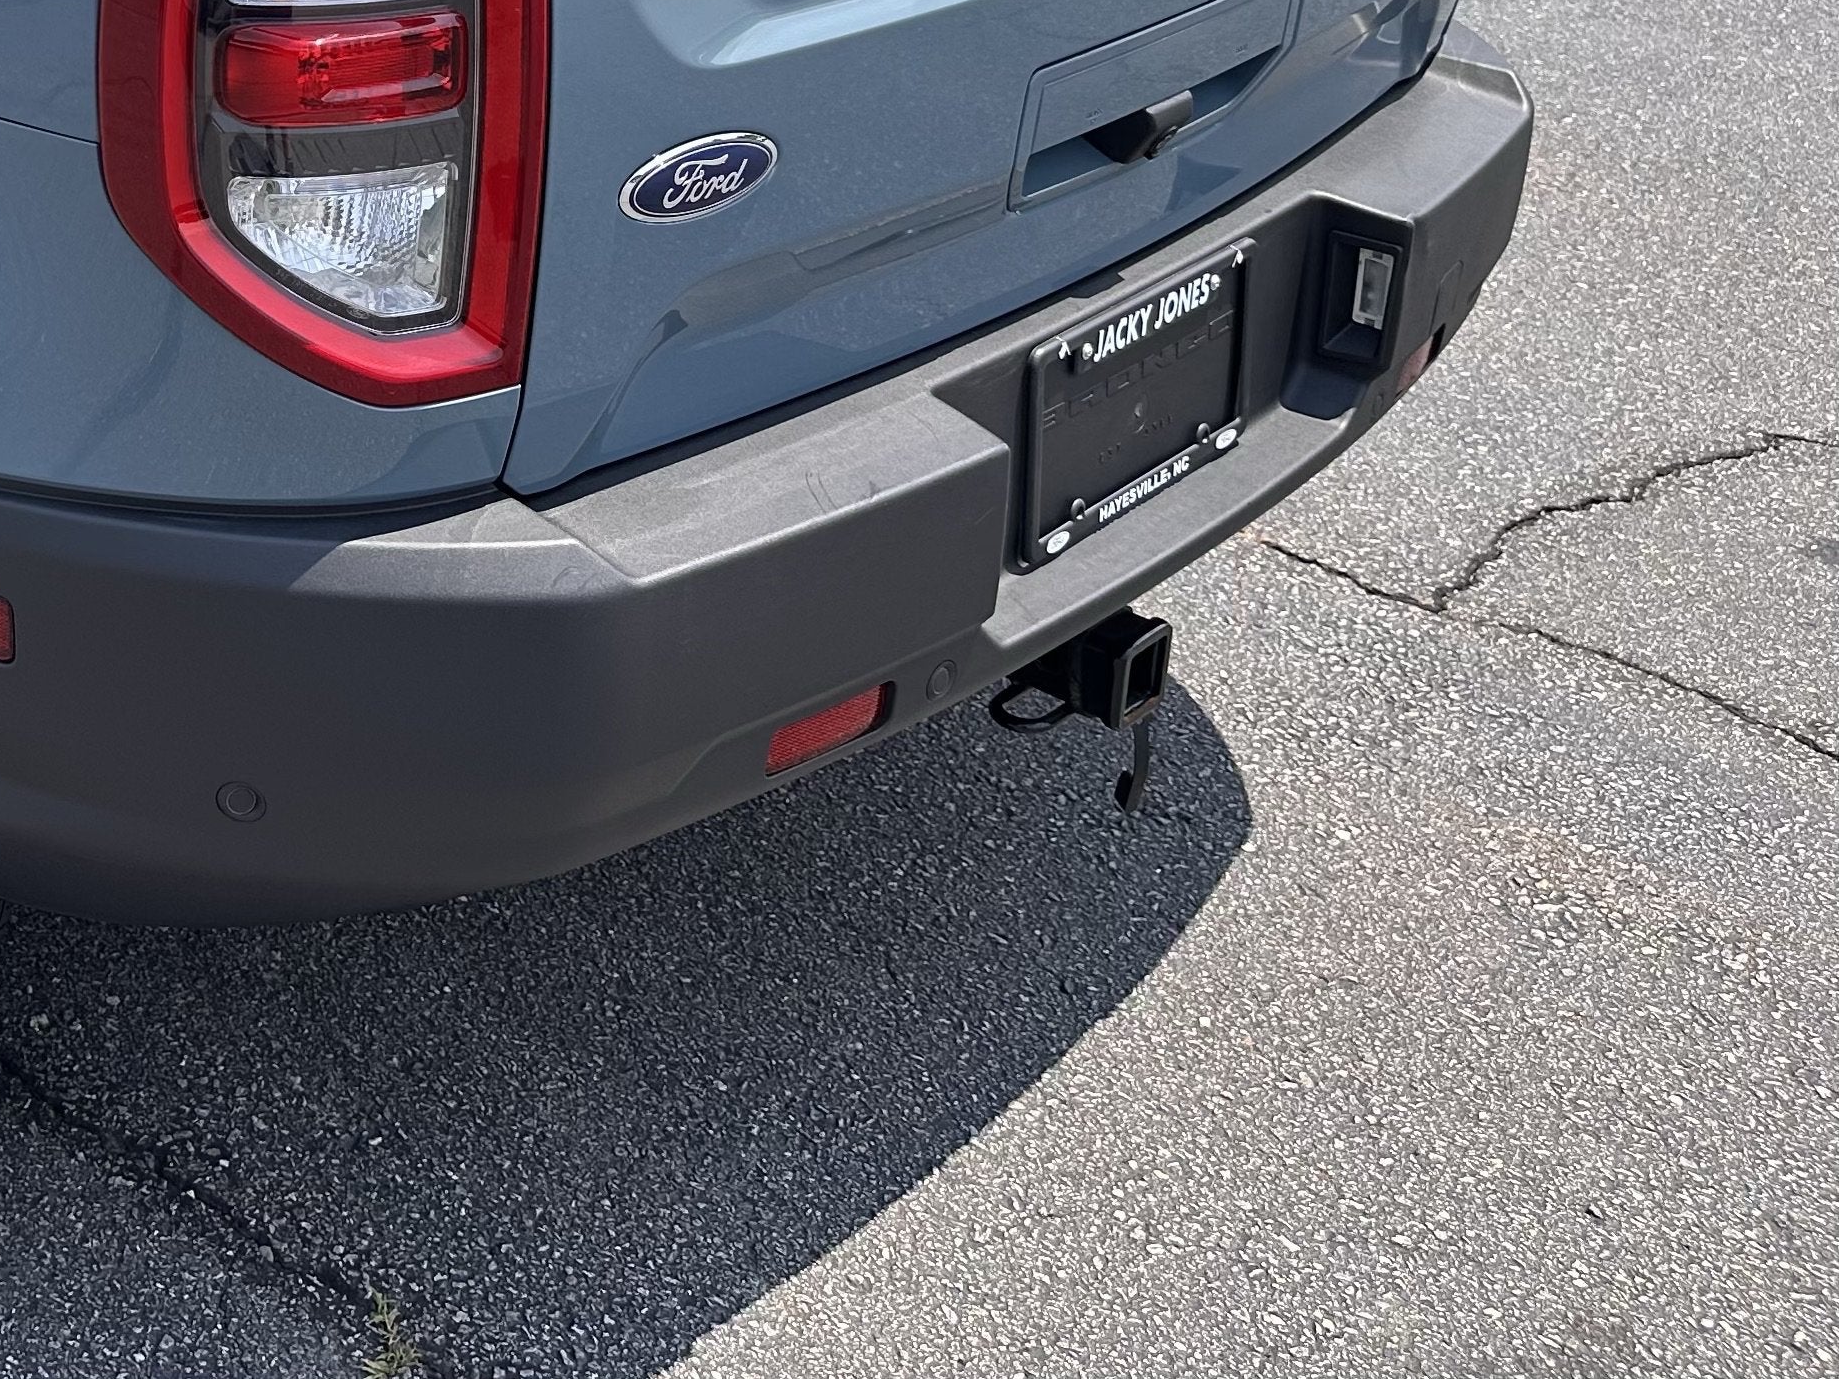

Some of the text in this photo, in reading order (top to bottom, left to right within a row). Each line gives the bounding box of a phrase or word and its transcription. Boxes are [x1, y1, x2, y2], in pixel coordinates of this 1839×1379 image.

[663, 153, 749, 209] Ford
[1093, 272, 1211, 363] JACKY JONES
[1172, 455, 1190, 477] NC
